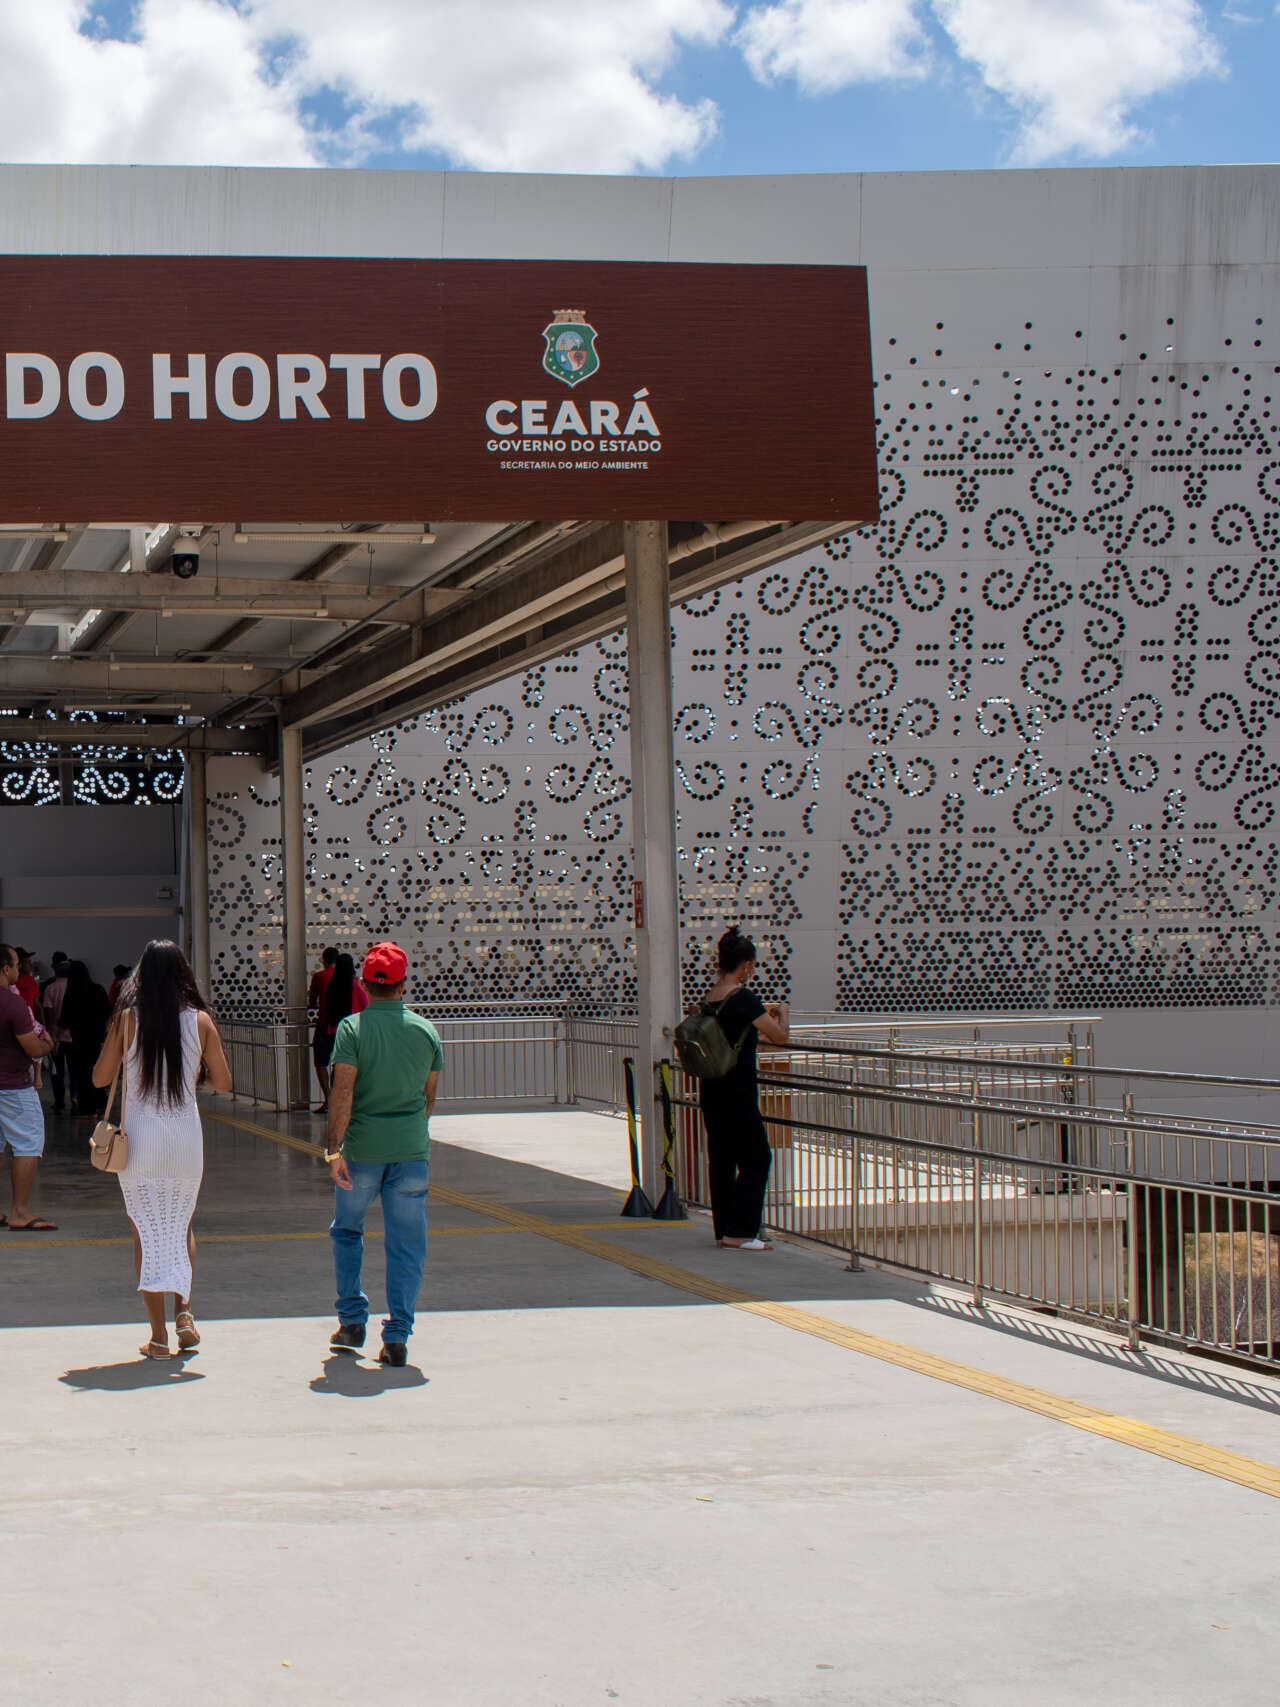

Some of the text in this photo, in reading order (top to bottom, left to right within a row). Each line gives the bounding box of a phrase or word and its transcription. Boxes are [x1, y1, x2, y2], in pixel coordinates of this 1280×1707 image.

[5, 351, 125, 423] DO
[152, 352, 439, 423] HORTO
[485, 387, 662, 437] CEARÁ
[486, 439, 662, 453] GOVERNO DO ESTADO
[500, 460, 649, 470] SECRETARIA DO MEIO AMBIENTE
